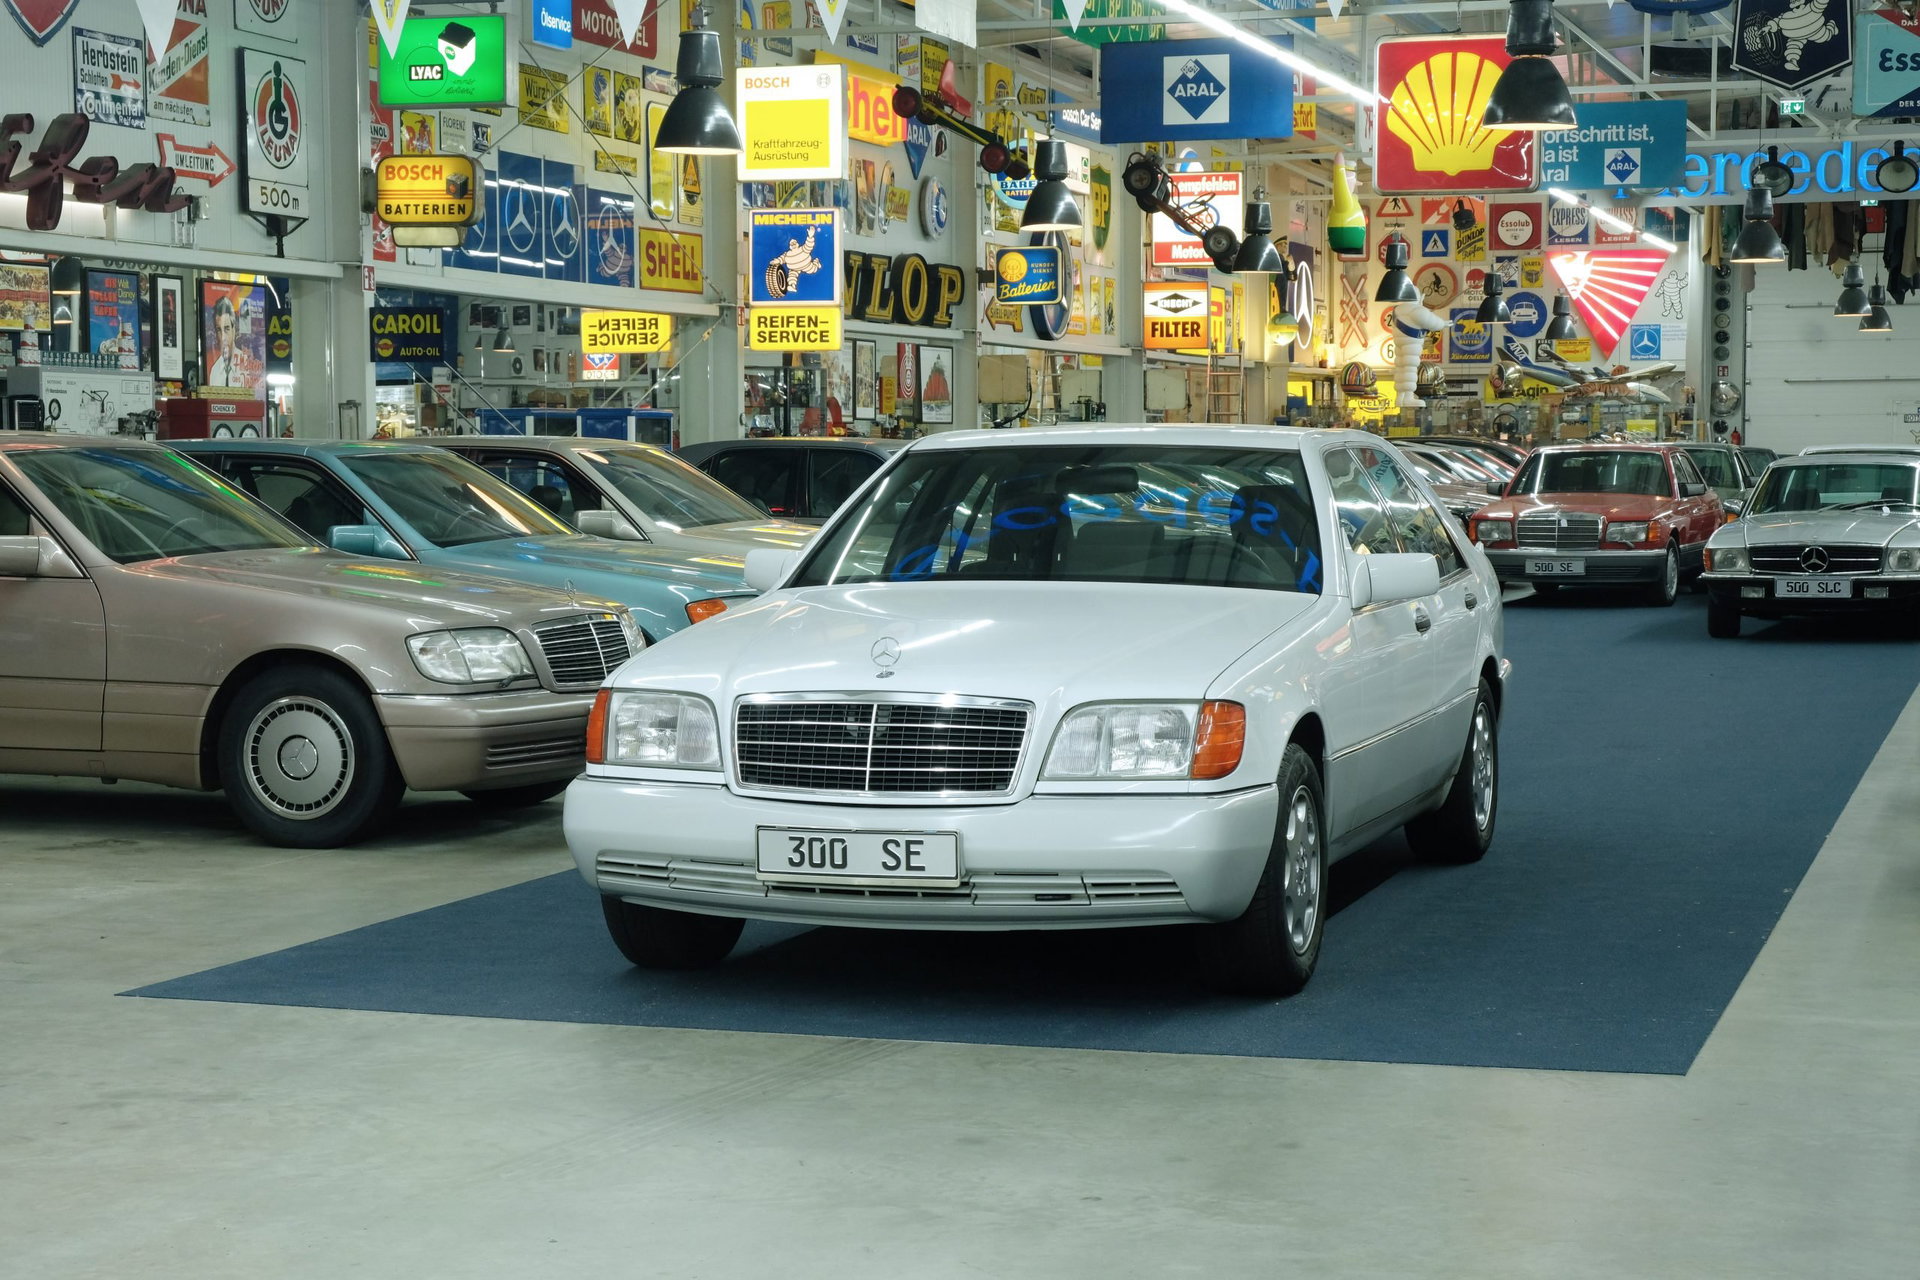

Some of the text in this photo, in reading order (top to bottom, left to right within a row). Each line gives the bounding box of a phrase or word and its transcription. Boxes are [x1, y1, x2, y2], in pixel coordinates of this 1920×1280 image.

[541, 7, 572, 32] Ölservice
[82, 40, 138, 75] Herbstein
[410, 66, 442, 80] LYAC
[745, 77, 790, 89] BOSCH
[1174, 83, 1219, 97] ARAL
[81, 90, 144, 120] Continental
[153, 101, 164, 111] am
[443, 116, 465, 131] FLORENZ
[1080, 109, 1091, 127] Car
[907, 123, 928, 147] ARAL
[1543, 124, 1654, 143] ortschritt ist,
[260, 127, 298, 163] LEUNA
[753, 139, 823, 149] Kraftfahrzeug-
[174, 151, 215, 172] UMLEITUNG
[753, 150, 809, 161] Ausrüstung
[1558, 146, 1578, 162] ist
[385, 164, 443, 180] BOSCH
[1609, 163, 1635, 171] ARAL
[1181, 176, 1237, 194] empfehlen
[260, 185, 291, 209] 500
[1091, 182, 1110, 228] BP
[385, 204, 466, 215] BATTERIEN
[1552, 207, 1586, 227] EXPRESS
[754, 213, 832, 225] MICHELIN
[1501, 219, 1530, 228] Essolub
[1456, 227, 1485, 250] DUNLOP
[645, 240, 699, 281] SHELL
[998, 279, 1056, 299] Batterien
[372, 313, 441, 334] CAROIL
[757, 315, 829, 328] REIFEN-
[1151, 321, 1201, 337] FILTER
[757, 330, 829, 343] SERVICE
[1507, 343, 1525, 361] ANA
[1514, 384, 1549, 398] Agip
[212, 404, 231, 412] SCHENCK
[1534, 562, 1574, 572] 500 SE
[1786, 581, 1841, 593] 500 SLC
[788, 836, 926, 872] 300 SE
